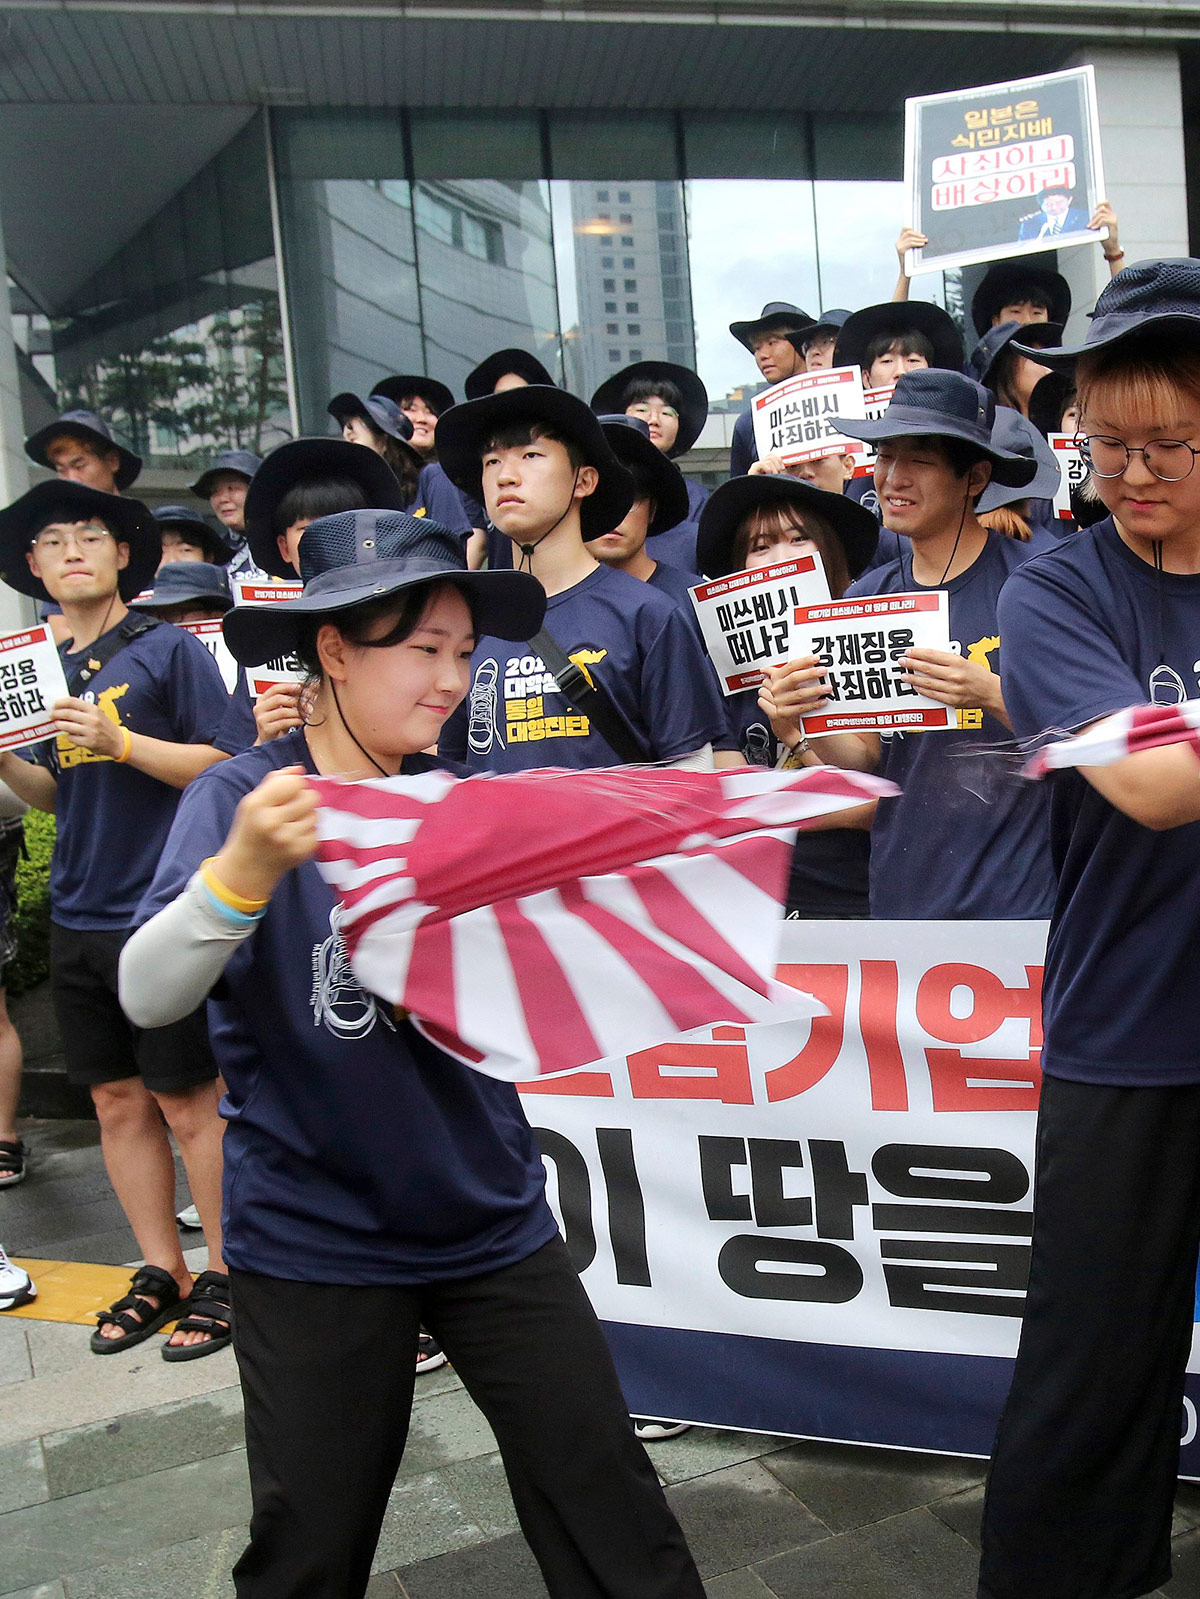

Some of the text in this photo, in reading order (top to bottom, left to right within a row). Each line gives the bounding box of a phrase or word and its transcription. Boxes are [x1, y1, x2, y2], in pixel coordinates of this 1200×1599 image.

[964, 100, 1039, 130] 일본은
[951, 117, 1053, 149] 식민지배
[769, 394, 840, 430] 미쓰비시
[716, 586, 799, 632] 미쓰비시
[812, 629, 915, 668] 강제징용
[0, 659, 38, 691] 징용
[505, 696, 543, 721] 통일
[506, 715, 590, 743] 대행진단
[698, 1134, 1034, 1318] 땅을
